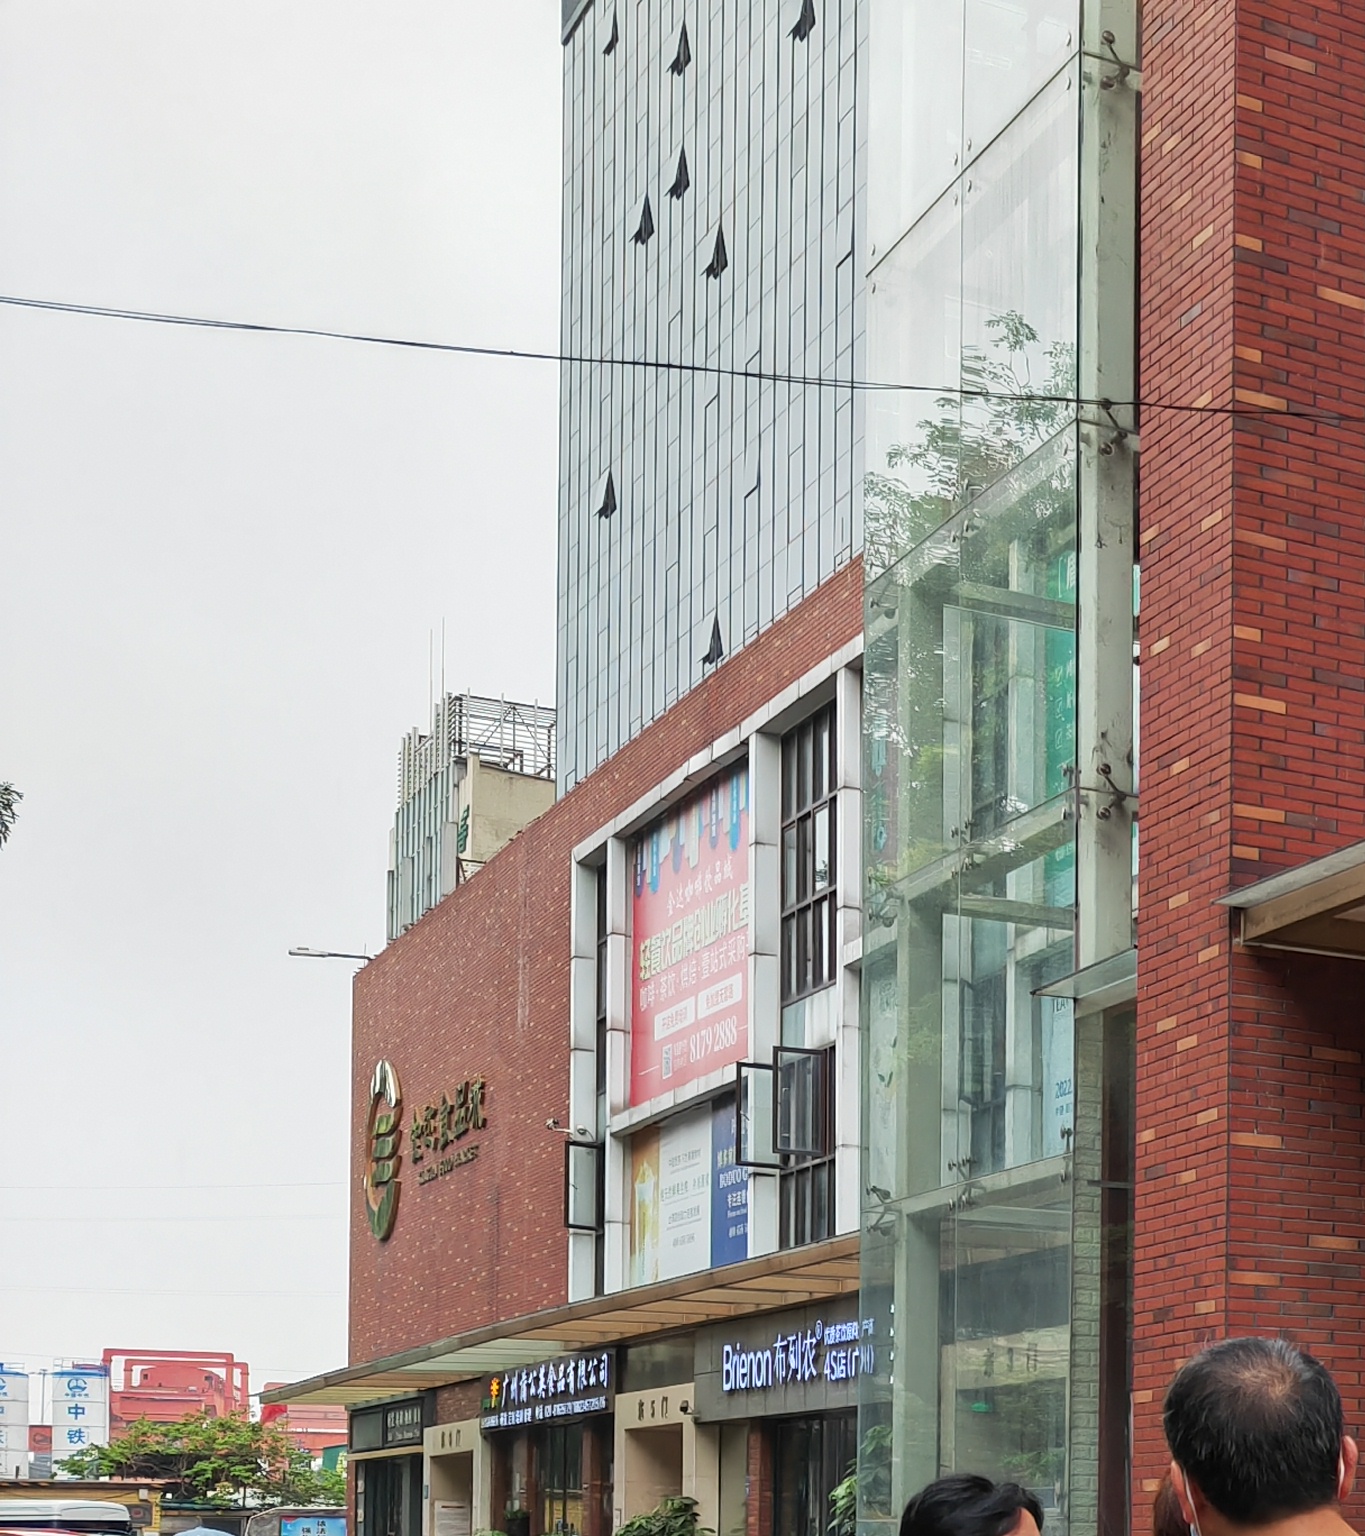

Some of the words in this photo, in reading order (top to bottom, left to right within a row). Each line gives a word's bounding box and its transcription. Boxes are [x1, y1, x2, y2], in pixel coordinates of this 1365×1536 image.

[690, 1025, 713, 1063] 8179
[713, 1016, 738, 1054] 2888
[722, 1343, 772, 1391] Brienon
[773, 1330, 818, 1384] 布列农
[67, 1403, 86, 1444] 中铁
